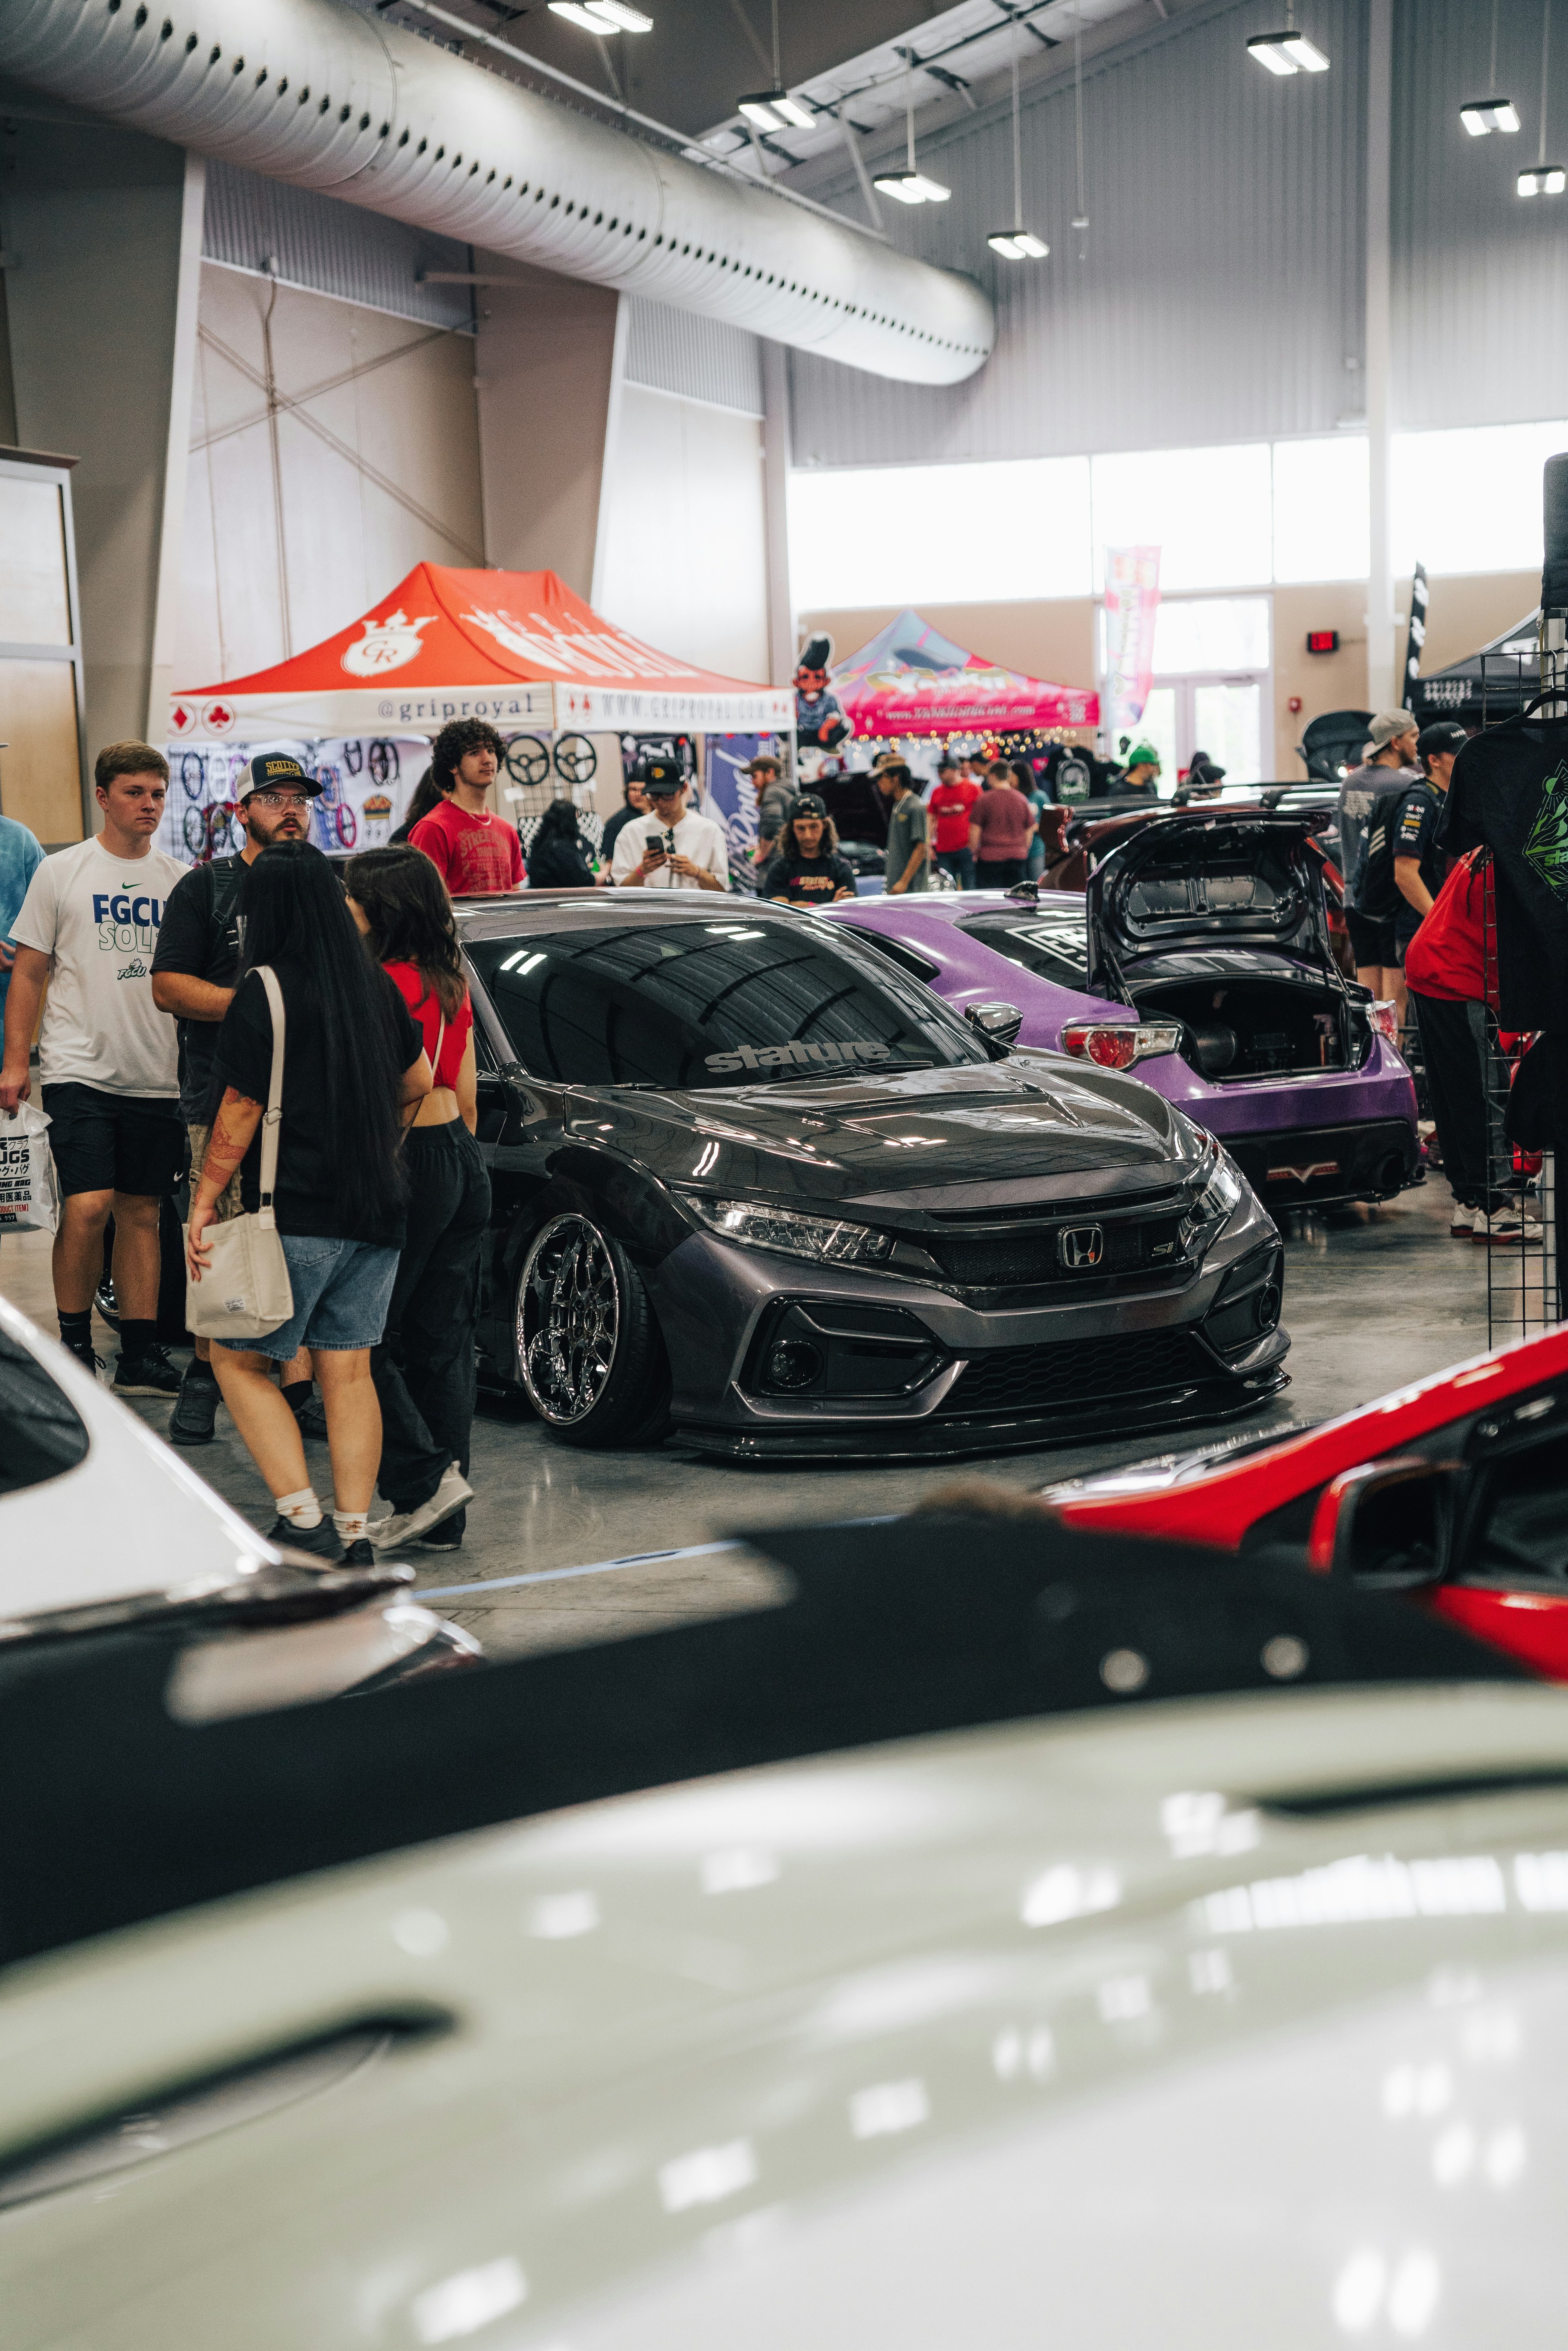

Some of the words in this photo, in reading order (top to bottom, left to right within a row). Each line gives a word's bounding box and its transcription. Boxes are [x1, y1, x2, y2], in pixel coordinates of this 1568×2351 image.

[378, 693, 533, 724] @griproyal
[265, 760, 300, 773] SCOTTY'S
[117, 966, 147, 980] FGCU
[704, 1040, 891, 1073] stature
[1152, 1242, 1174, 1257] Si
